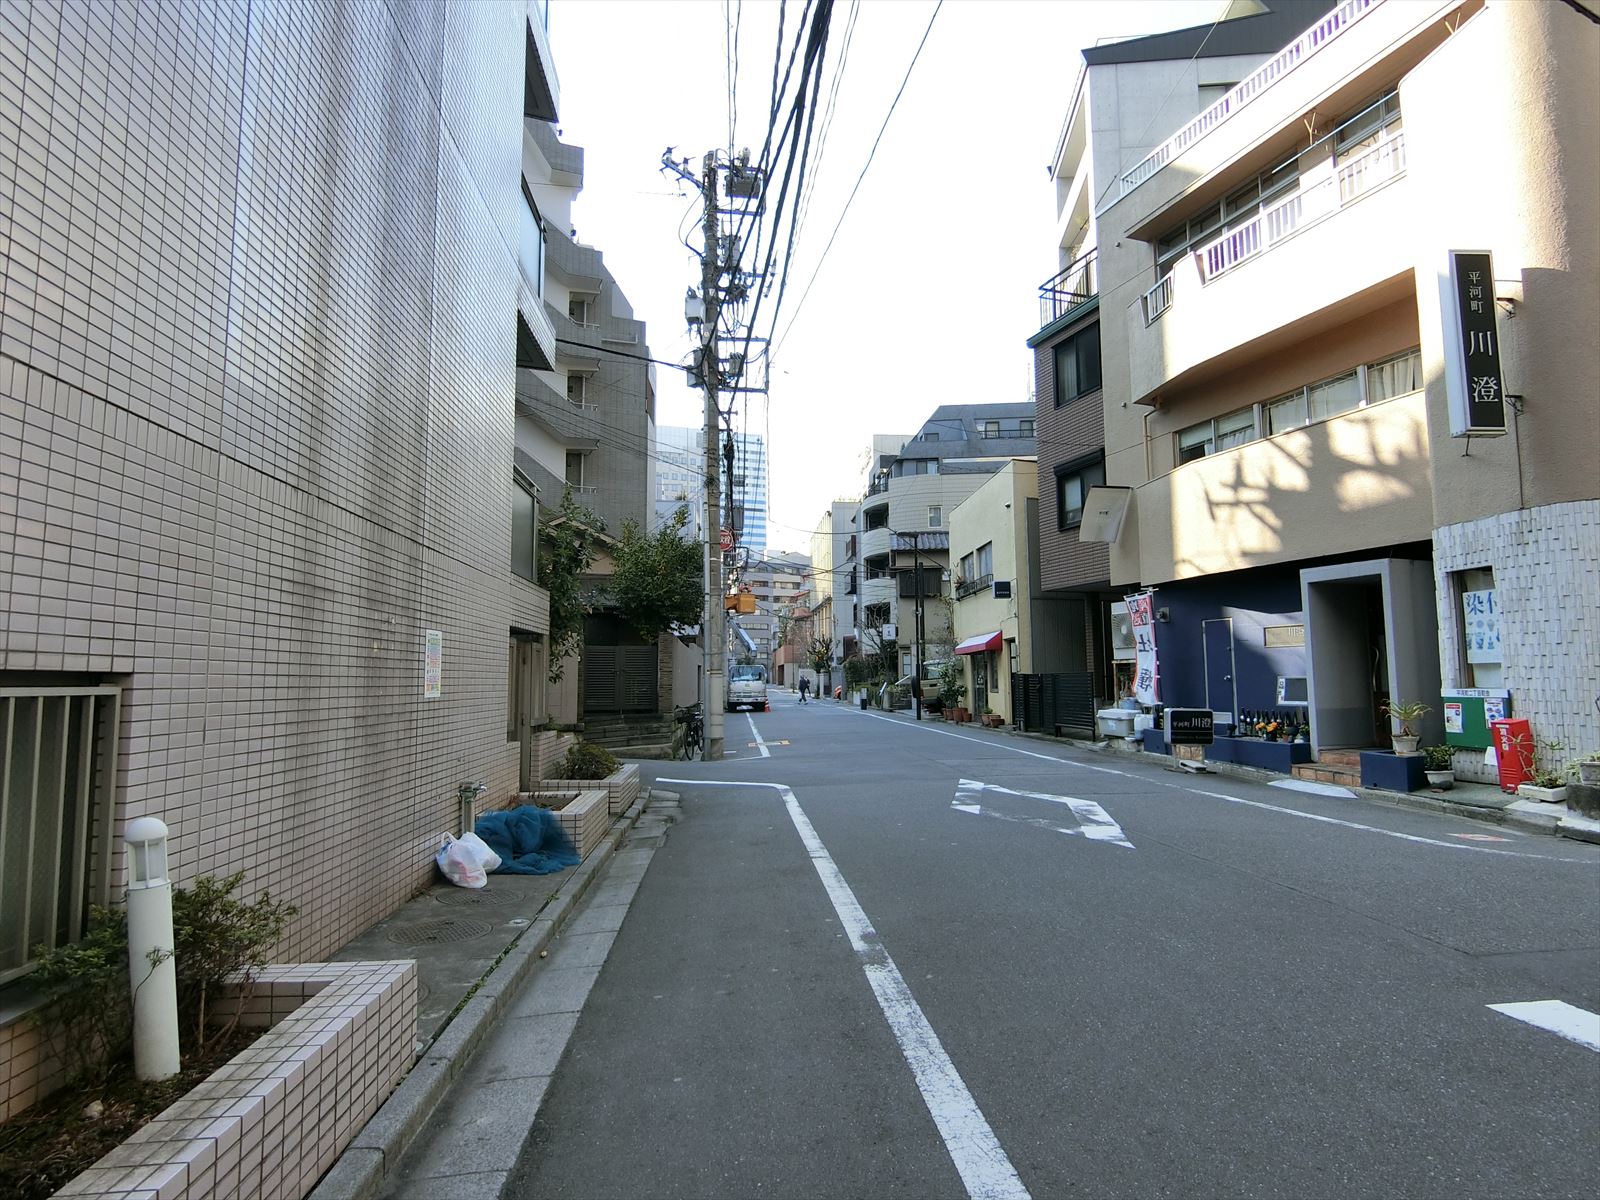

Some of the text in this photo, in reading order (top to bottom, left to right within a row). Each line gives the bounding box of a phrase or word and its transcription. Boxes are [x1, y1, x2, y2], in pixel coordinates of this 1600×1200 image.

[1468, 271, 1499, 402] 平河町 川澄
[1191, 717, 1211, 728] 川澄
